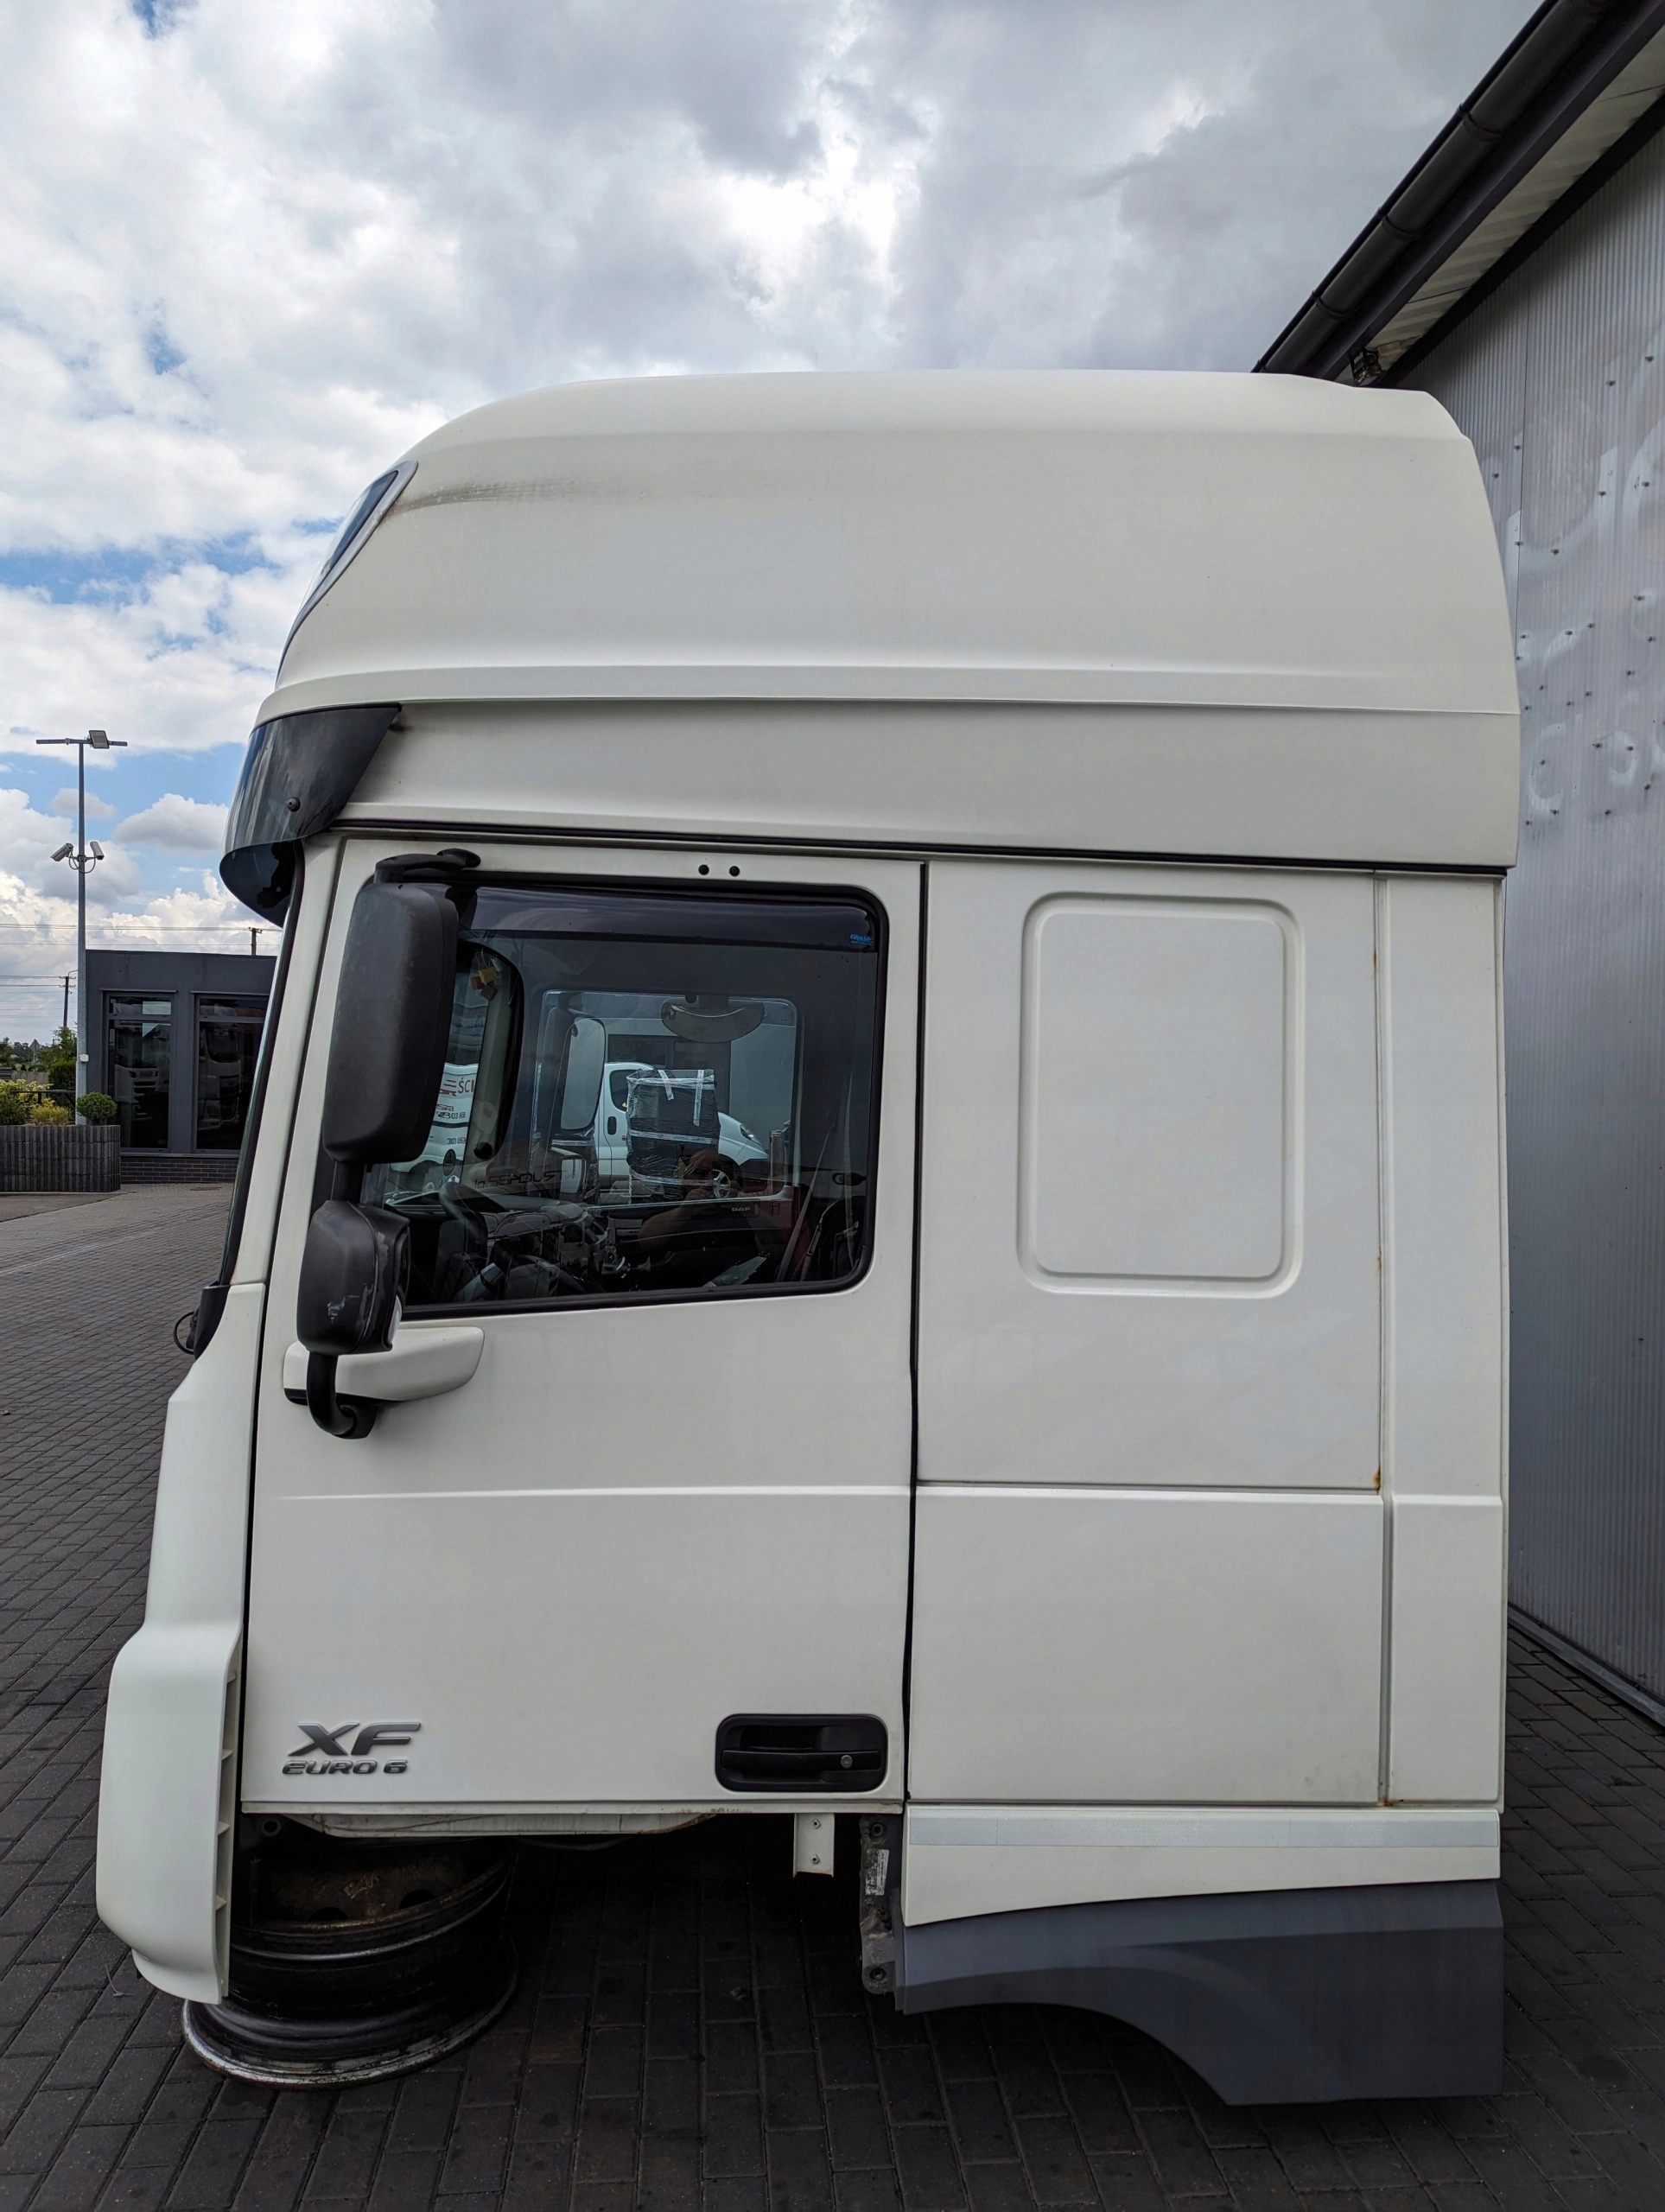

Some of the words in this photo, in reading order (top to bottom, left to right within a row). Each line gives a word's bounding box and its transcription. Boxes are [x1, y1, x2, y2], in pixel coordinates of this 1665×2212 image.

[288, 1721, 422, 1757] XF
[282, 1759, 378, 1775] EURO
[383, 1758, 409, 1775] 6
